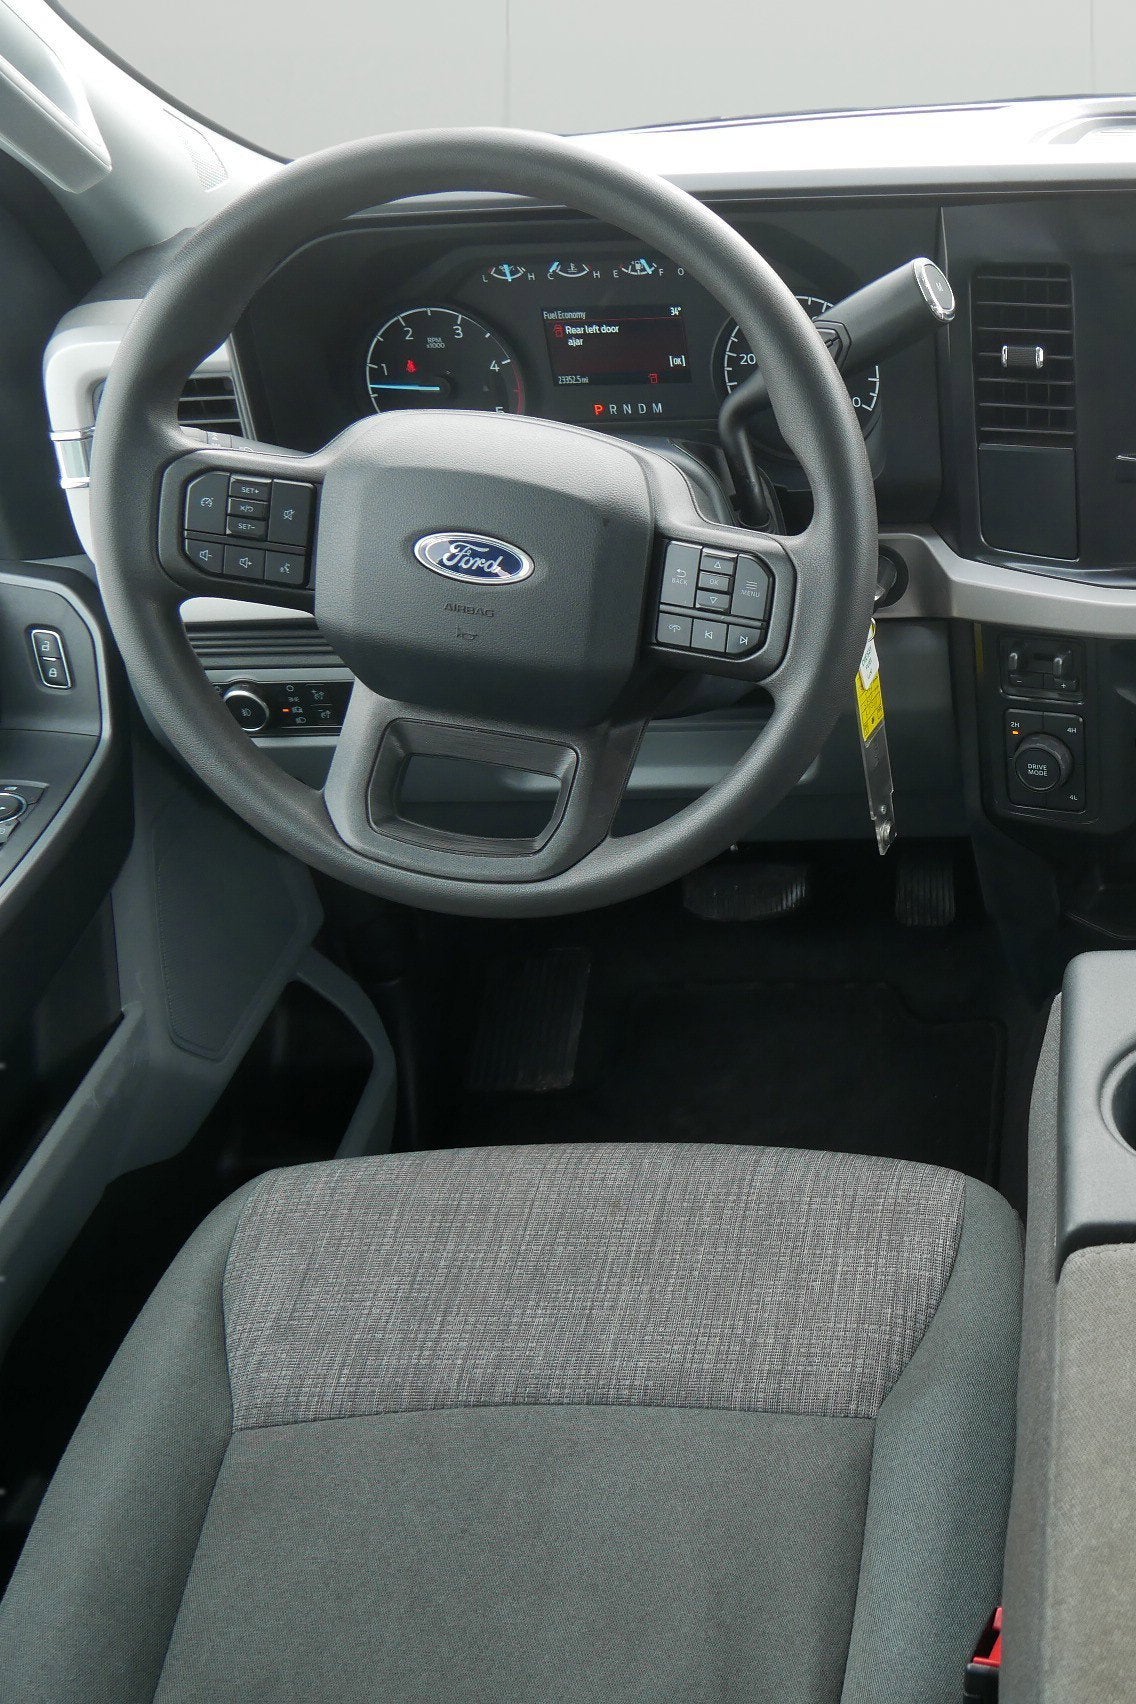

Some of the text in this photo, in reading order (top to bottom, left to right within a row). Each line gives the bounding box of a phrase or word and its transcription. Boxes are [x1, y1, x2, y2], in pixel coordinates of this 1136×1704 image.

[528, 272, 535, 281] H
[547, 272, 555, 280] C
[593, 271, 600, 279] H
[613, 270, 620, 278] E
[658, 268, 664, 277] F
[543, 310, 586, 321] Fuel Economy
[403, 327, 414, 340] 2
[453, 325, 464, 339] 3
[565, 324, 619, 335] Rear left door
[567, 338, 584, 347] ajar
[739, 353, 756, 365] 20
[381, 363, 388, 376] 1
[489, 360, 500, 372] 4
[594, 402, 663, 415] P R N D M
[241, 486, 260, 494] SET+
[442, 541, 504, 574] Ford
[671, 578, 688, 586] BACK
[740, 589, 760, 598] MENU
[443, 602, 495, 618] AIRBAG
[1027, 763, 1048, 771] DRIVE
[1027, 769, 1048, 777] MODE
